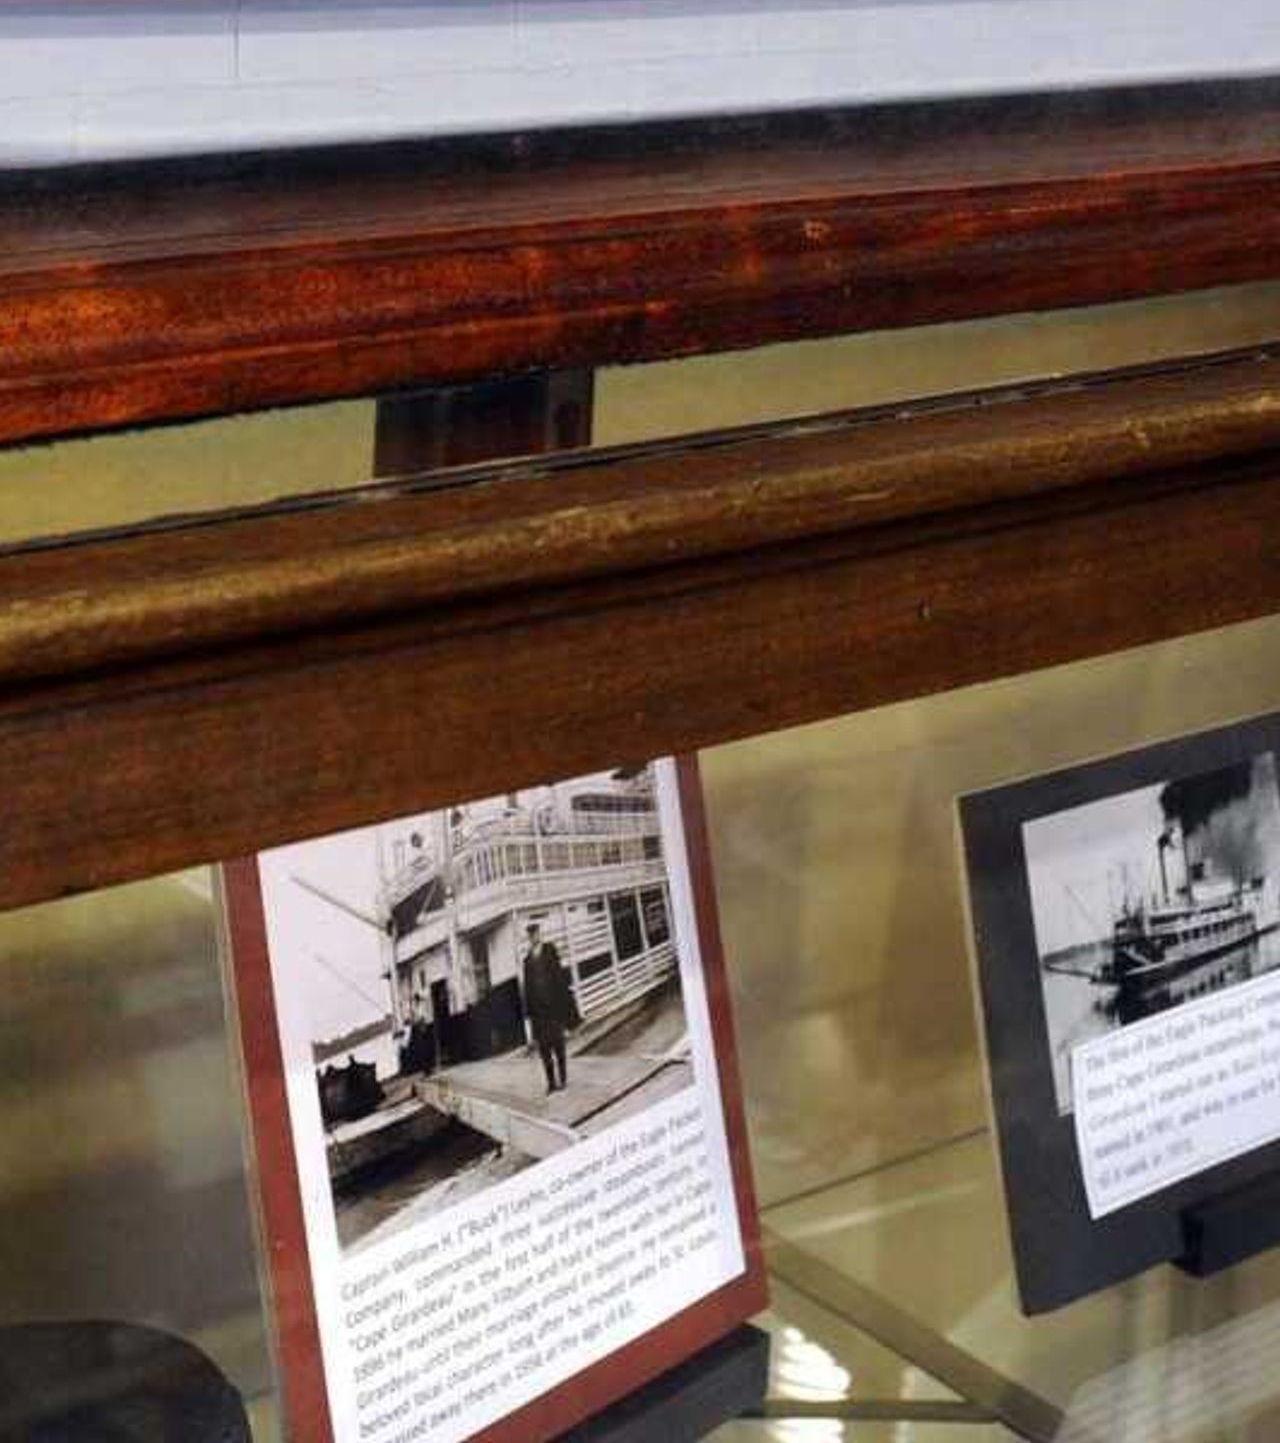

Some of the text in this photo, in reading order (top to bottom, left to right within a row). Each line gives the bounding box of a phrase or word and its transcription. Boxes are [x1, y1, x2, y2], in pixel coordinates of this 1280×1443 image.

[391, 1239, 439, 1274] William
[617, 1136, 638, 1157] the
[478, 1261, 502, 1286] the
[504, 1246, 530, 1272] first
[531, 1233, 555, 1258] half
[572, 1212, 593, 1235] the
[345, 1284, 407, 1329] Company,
[414, 1239, 493, 1290] commanded
[498, 1219, 531, 1246] three
[404, 1314, 455, 1353] married
[535, 1259, 558, 1282] and
[559, 1246, 583, 1269] had
[593, 1222, 627, 1251] home
[451, 1329, 483, 1357] their
[485, 1301, 539, 1340] marriage
[540, 1277, 578, 1308] ended
[413, 1380, 443, 1406] local
[445, 1346, 504, 1388] character
[507, 1329, 535, 1356] long
[536, 1312, 565, 1338] after
[585, 1278, 627, 1310] moved
